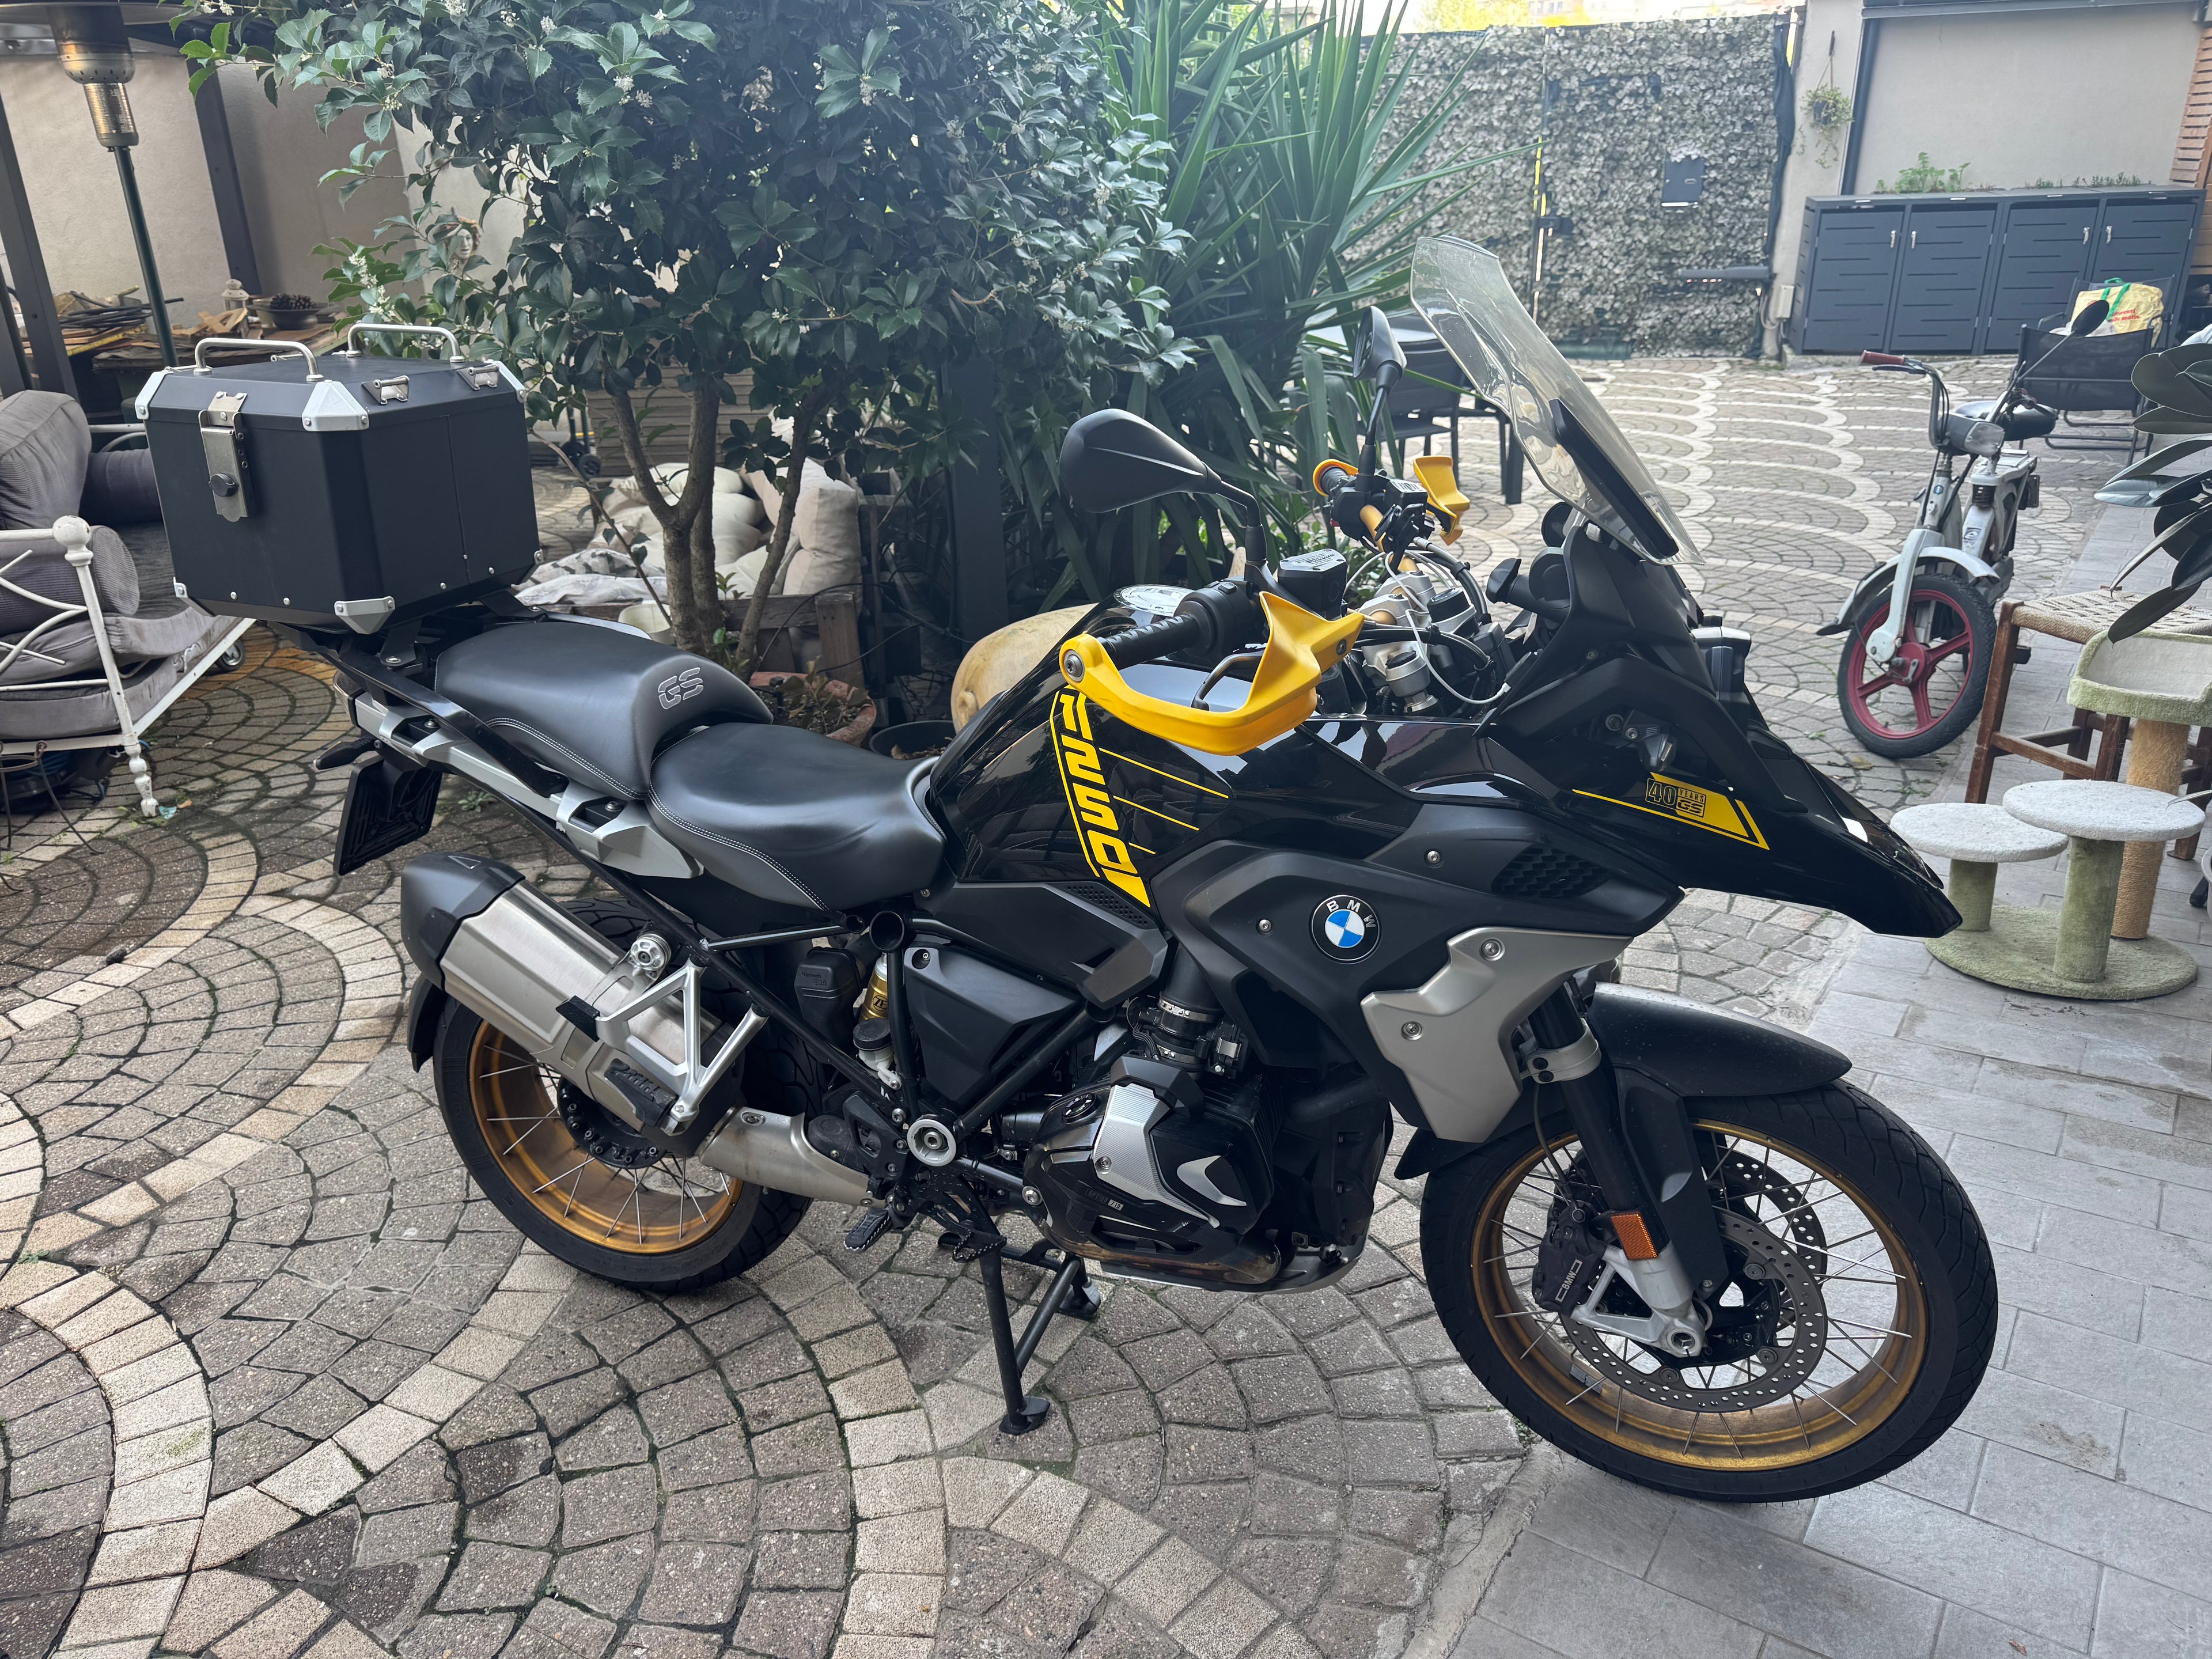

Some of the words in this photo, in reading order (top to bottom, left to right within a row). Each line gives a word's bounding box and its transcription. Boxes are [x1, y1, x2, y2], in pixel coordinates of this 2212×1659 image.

[658, 667, 704, 710] GS
[1648, 782, 1676, 806] 40
[1679, 789, 1704, 802] YEARS
[1677, 799, 1703, 813] GS
[1326, 899, 1376, 928] BMW
[1562, 1270, 1577, 1290] BMW
